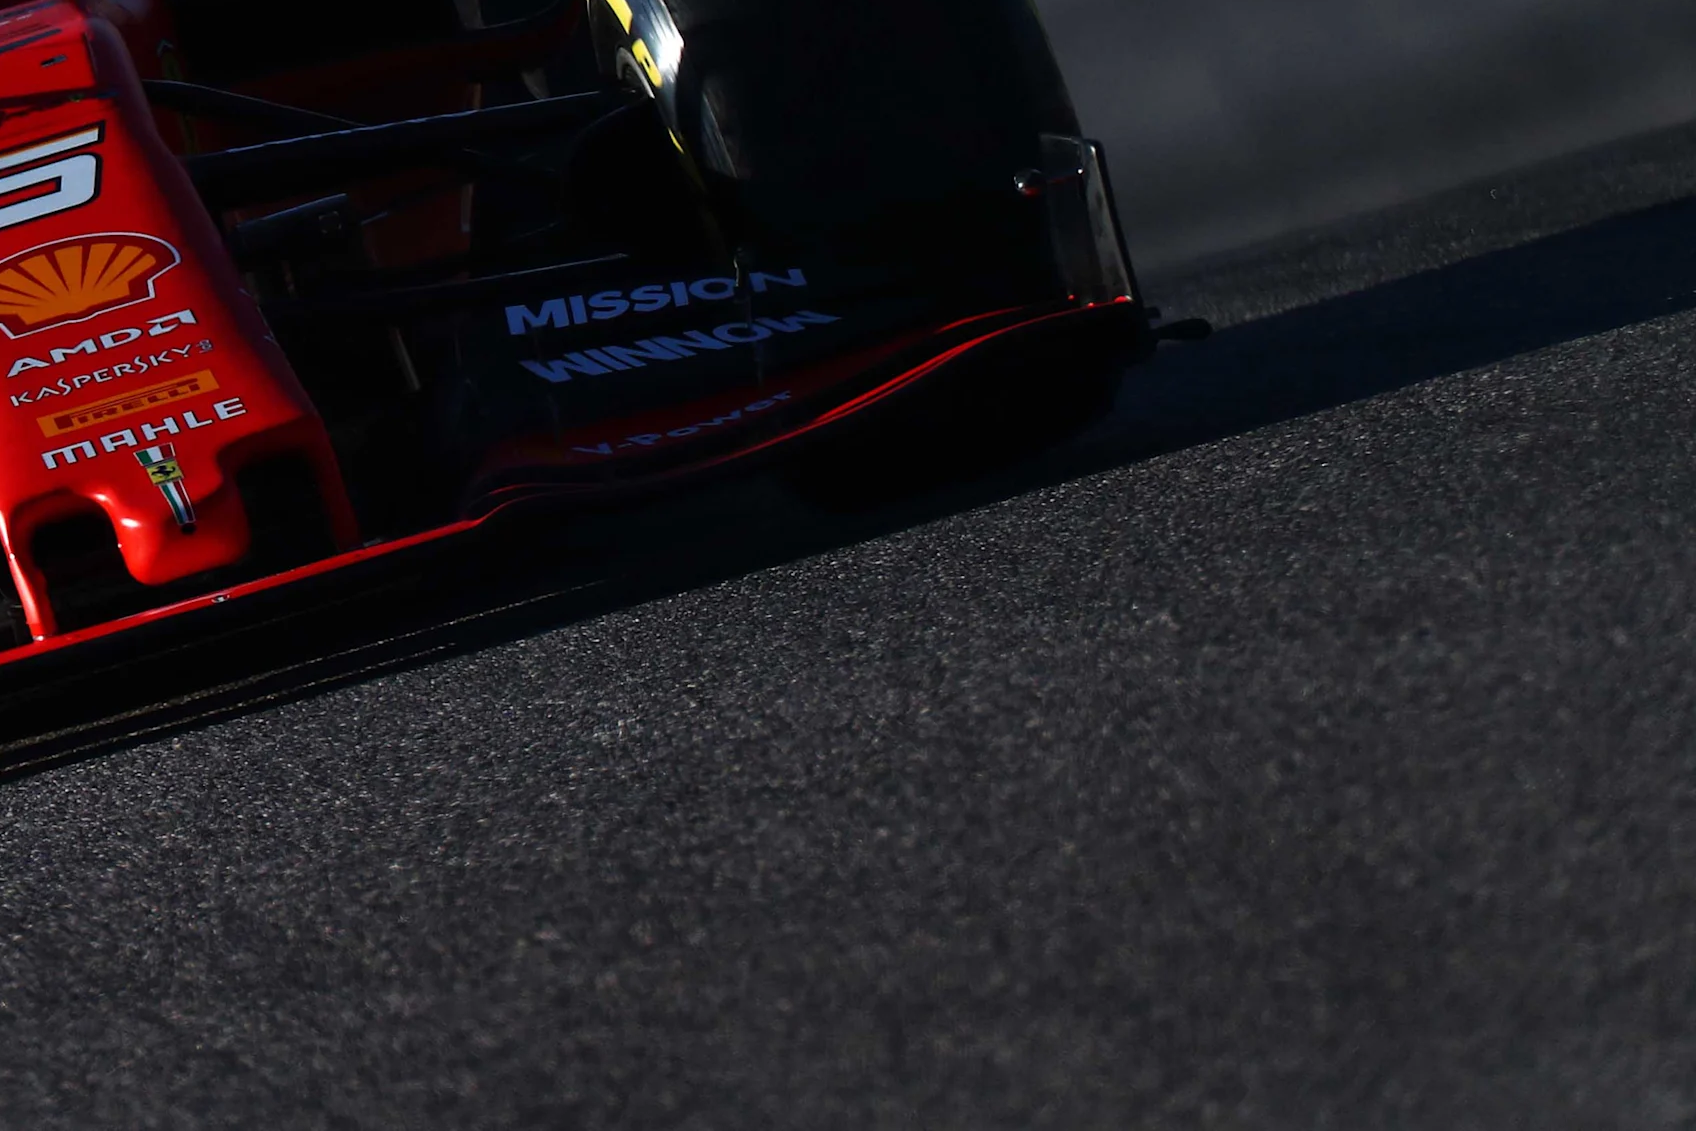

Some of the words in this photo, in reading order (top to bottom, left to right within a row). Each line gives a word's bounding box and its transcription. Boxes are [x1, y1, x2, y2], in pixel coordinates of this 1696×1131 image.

[505, 268, 808, 336] MISSION
[10, 344, 192, 408] KASPERSKY
[519, 310, 844, 384] WINNOW
[41, 397, 247, 470] MAHLE
[54, 378, 201, 430] PIRELLI
[571, 389, 793, 457] V-Power
